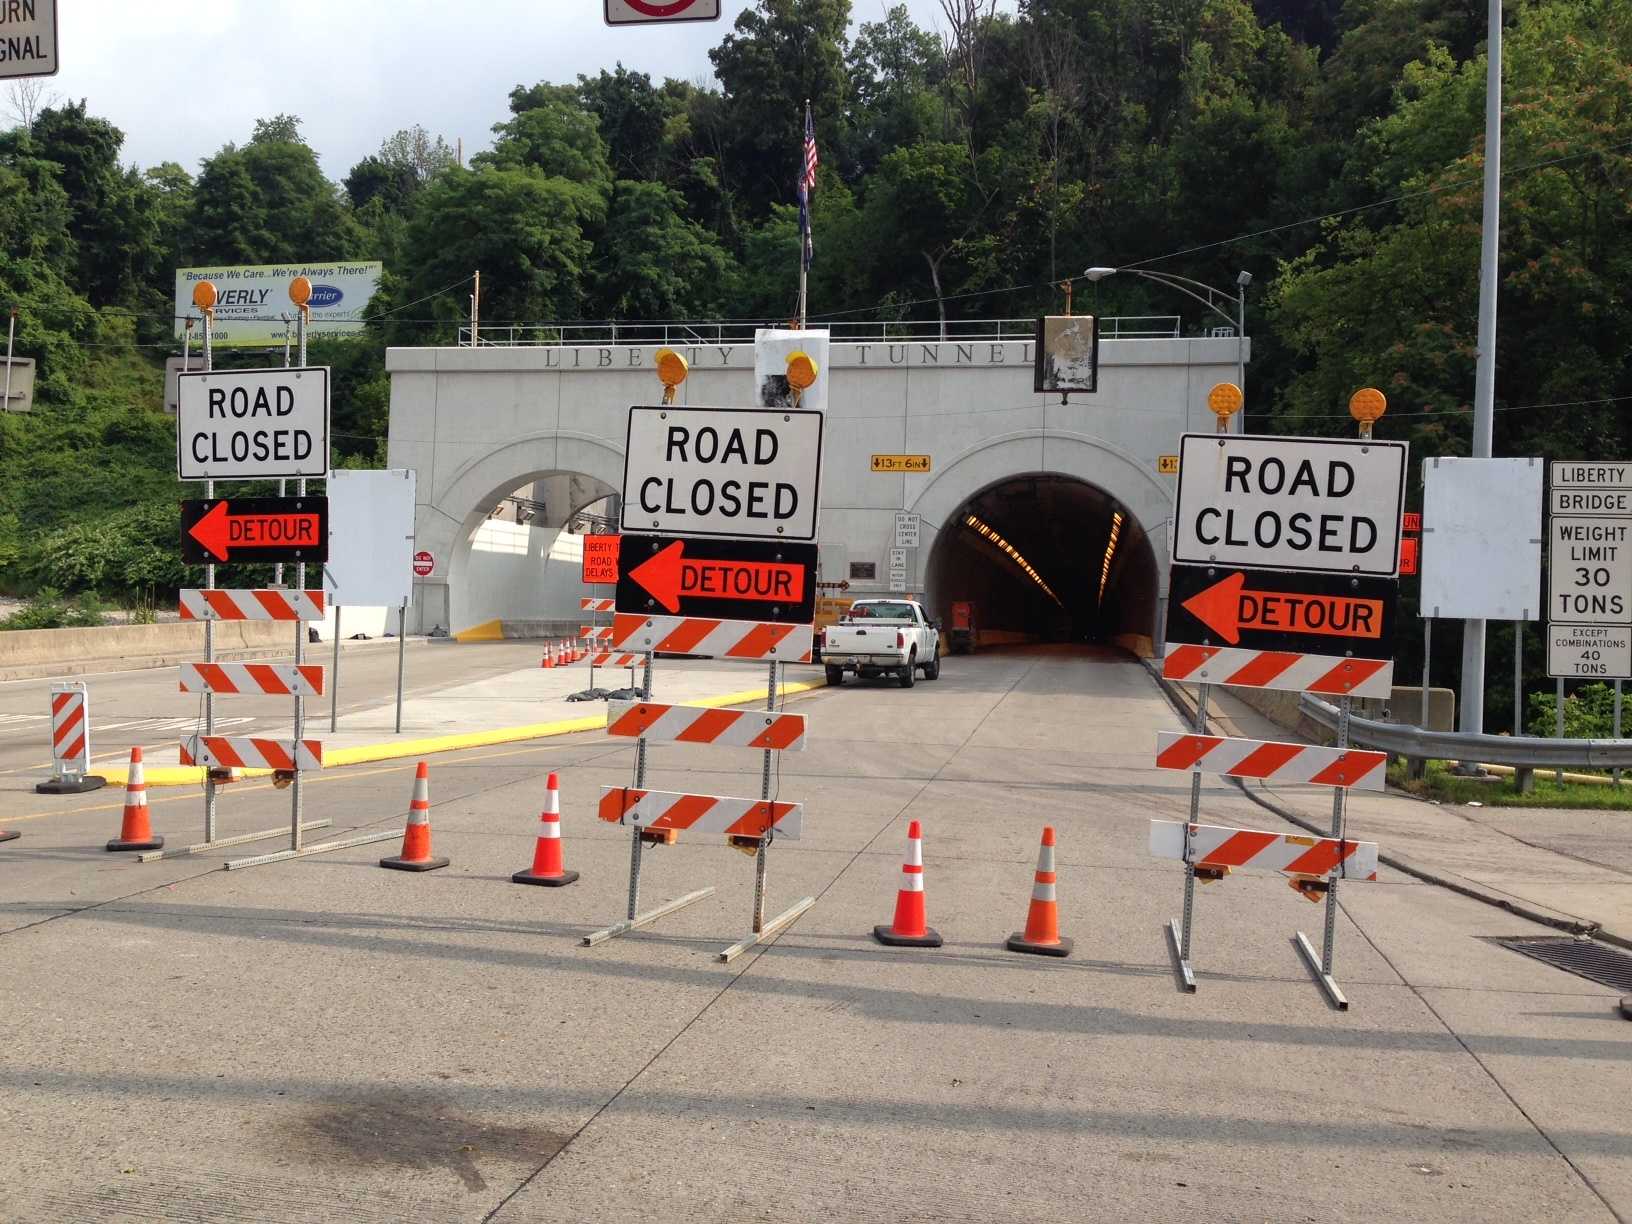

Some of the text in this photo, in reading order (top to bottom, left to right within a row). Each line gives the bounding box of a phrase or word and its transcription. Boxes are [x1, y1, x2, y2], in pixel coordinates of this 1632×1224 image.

[226, 270, 241, 279] We
[300, 267, 334, 277] Always
[192, 288, 269, 305] VERLY
[545, 347, 734, 368] LIBETY
[208, 385, 295, 418] ROAD
[191, 430, 312, 463] CLOSED
[665, 426, 779, 466] ROAD
[1224, 456, 1355, 498] ROAD
[1561, 467, 1625, 483] LIBERTY
[640, 476, 798, 520] CLOSED
[1560, 494, 1627, 509] BRIDGE
[228, 518, 313, 542] DETOUR
[1195, 507, 1378, 554] CLOSED
[1560, 526, 1627, 541] WEIGHT
[590, 556, 612, 566] ROAD
[1571, 546, 1618, 561] LIMIT
[585, 567, 613, 577] DELAYS
[680, 565, 793, 597] DETOUR
[1574, 567, 1611, 587] 30
[1559, 594, 1624, 614] TONS
[1237, 594, 1373, 633] DETOUR
[1572, 628, 1609, 637] EXCEPT
[1555, 638, 1626, 648] COMBINATIONS
[1580, 650, 1601, 661] 40
[1574, 663, 1608, 674] TONS
